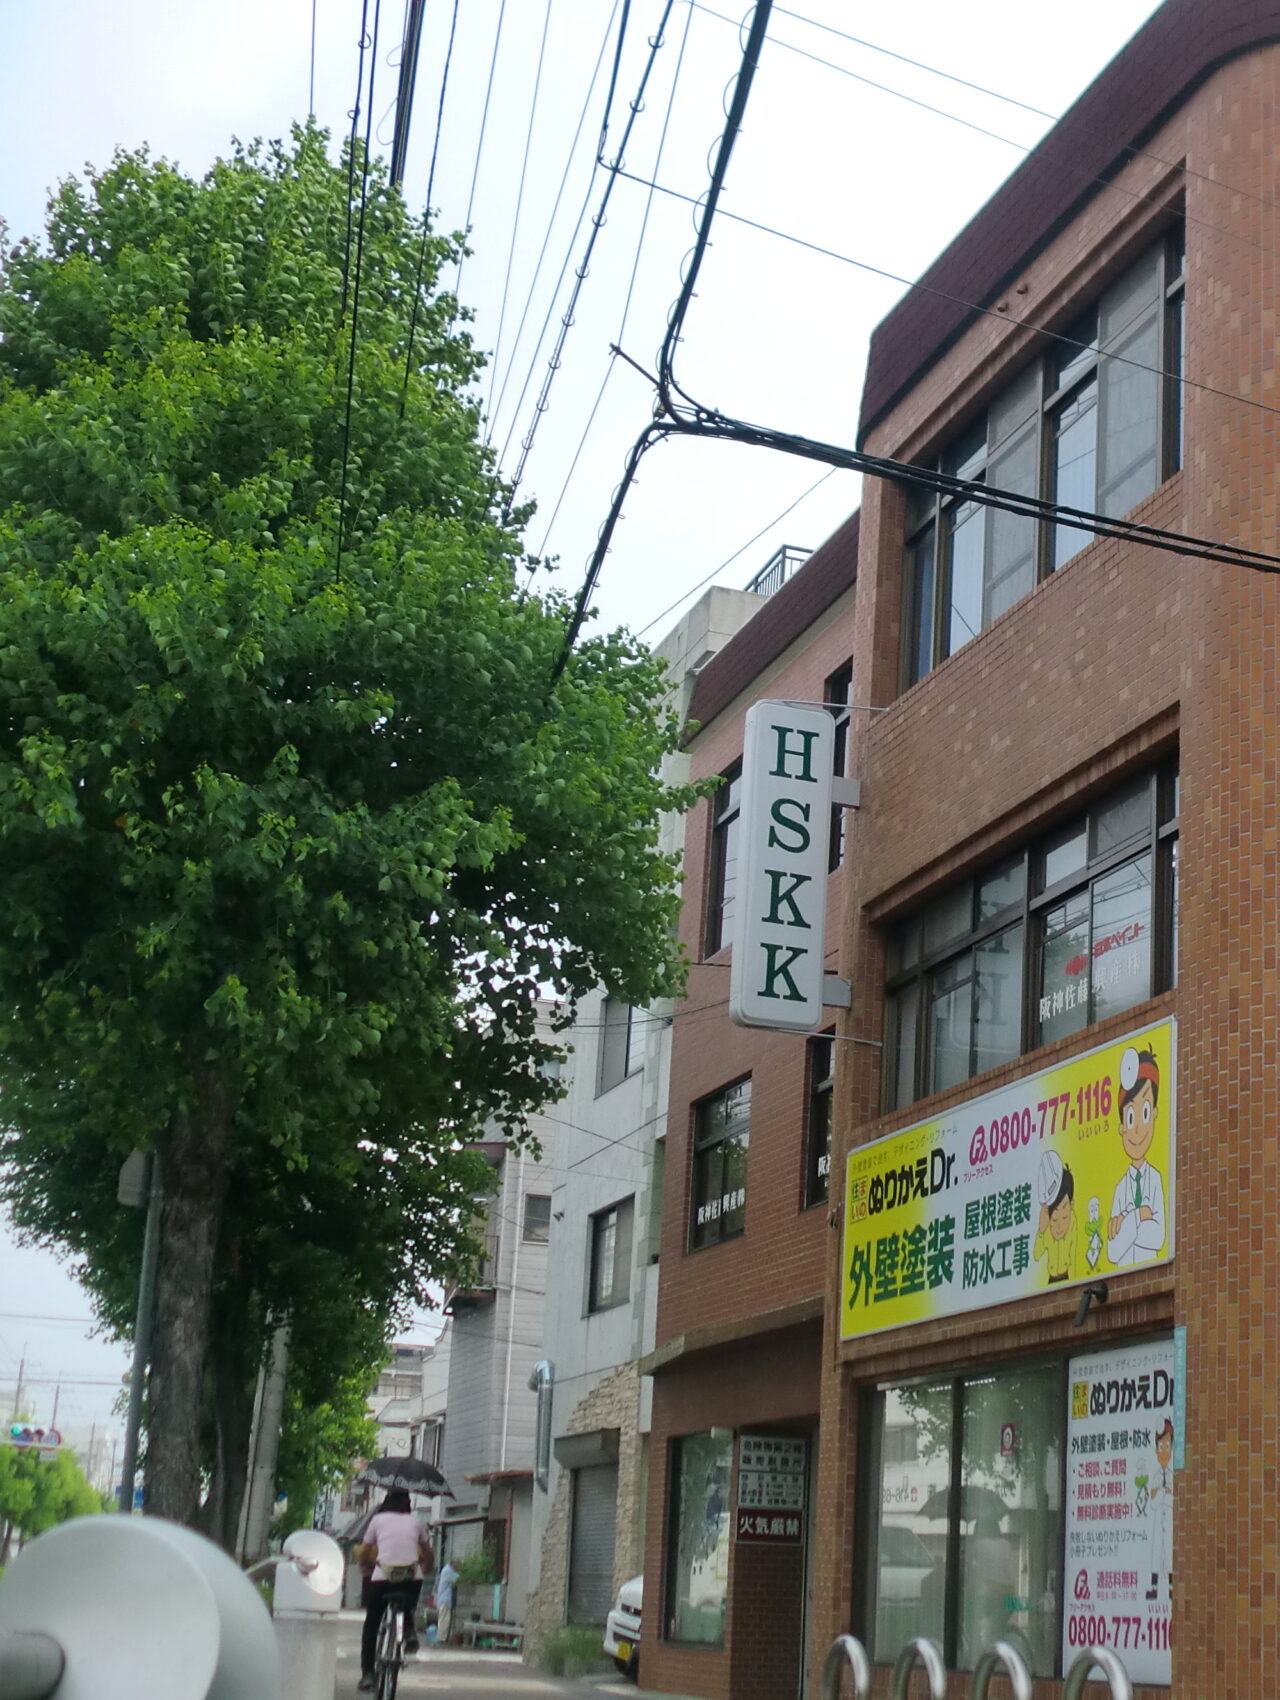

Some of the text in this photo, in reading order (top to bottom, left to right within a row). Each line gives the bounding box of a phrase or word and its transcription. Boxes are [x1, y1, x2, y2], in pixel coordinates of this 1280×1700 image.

[757, 725, 819, 1003] HSKK
[989, 1076, 1112, 1157] 0800-777-1116
[1078, 1119, 1110, 1141] いいいろ
[868, 1147, 958, 1215] ぬりかえDr.
[963, 1164, 994, 1183] フリーアクセス
[964, 1182, 1031, 1240] 屋根塗装
[848, 1214, 956, 1310] 外壁塗装
[962, 1234, 1030, 1290] 防水工事
[740, 1516, 799, 1536] 火気厳禁
[1069, 1614, 1172, 1651] 0800-777-111
